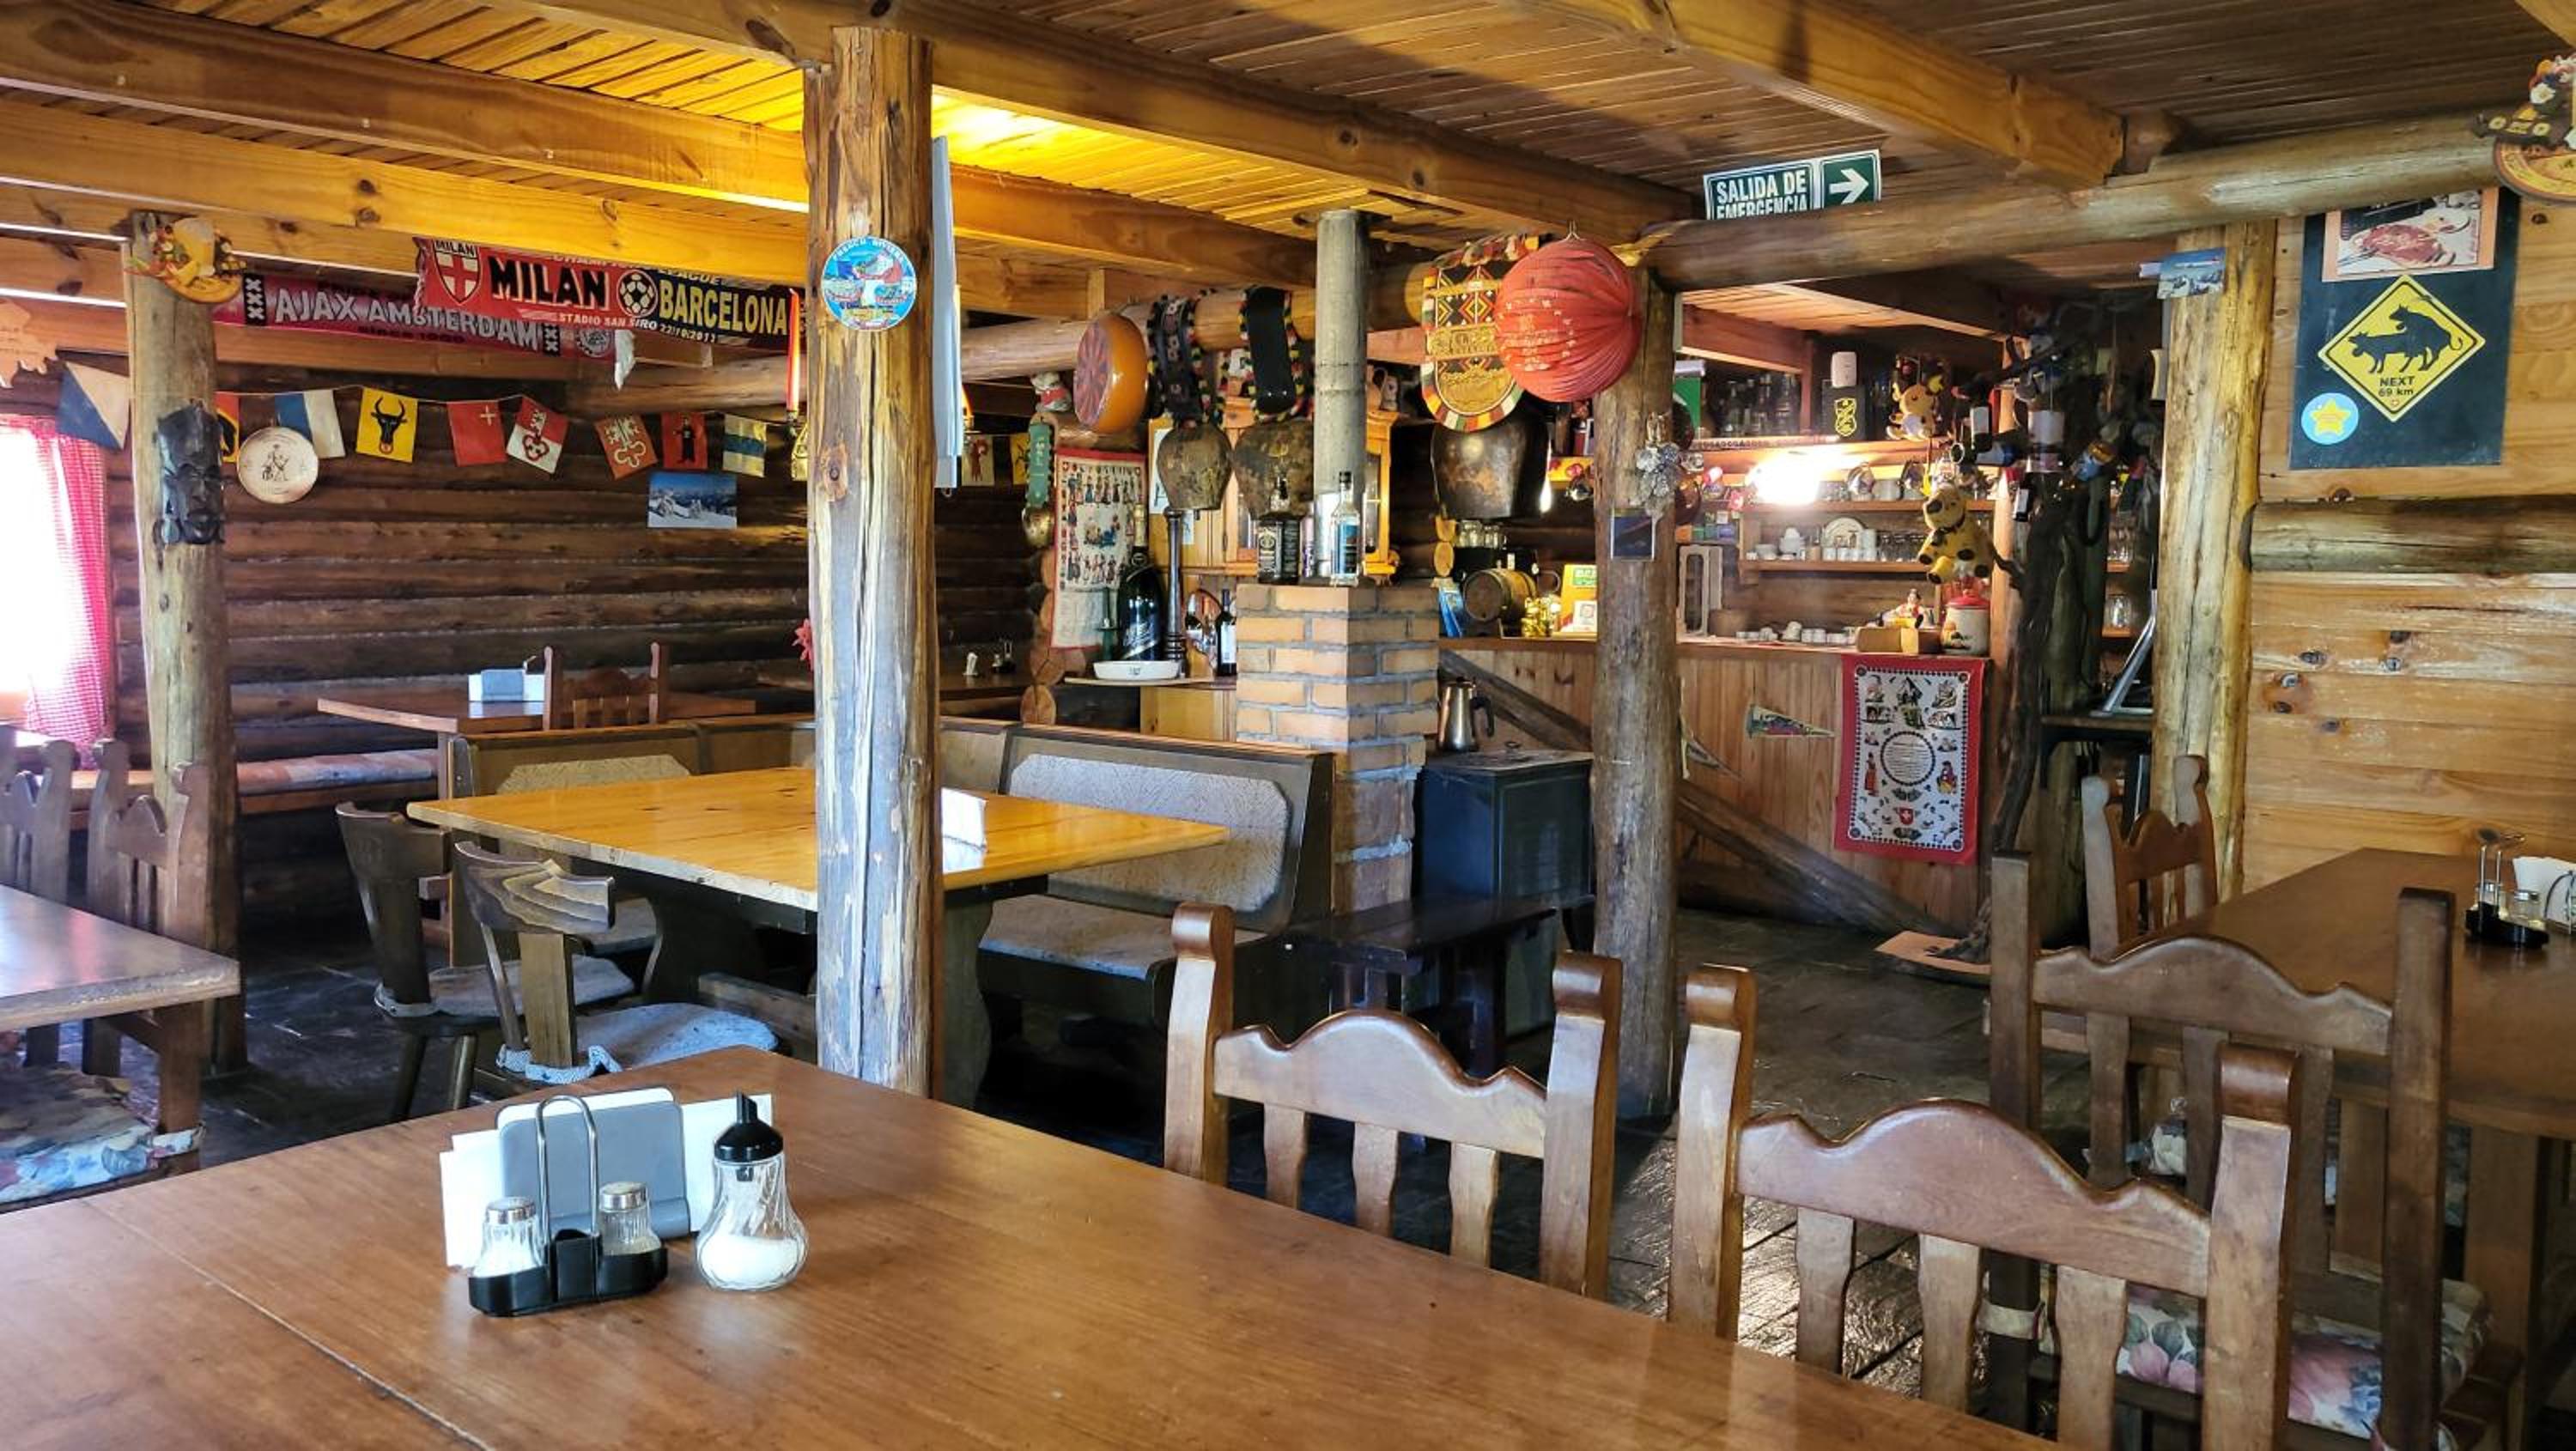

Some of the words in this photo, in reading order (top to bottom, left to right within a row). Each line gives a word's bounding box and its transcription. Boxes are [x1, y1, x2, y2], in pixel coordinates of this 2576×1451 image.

[1717, 173, 1778, 205] SALIDA
[1783, 169, 1807, 196] DE
[434, 239, 477, 256] MILAN
[487, 256, 611, 312] MILAN
[274, 288, 358, 324] AJAX
[368, 300, 539, 352] AMSTERDAM
[556, 312, 601, 327] STADIO
[604, 316, 627, 328] SAN
[629, 319, 658, 331] SIRO
[658, 279, 788, 337] BARCELONA
[2378, 387, 2393, 398] 69
[2396, 386, 2415, 397] km
[2379, 375, 2415, 387] NEXT
